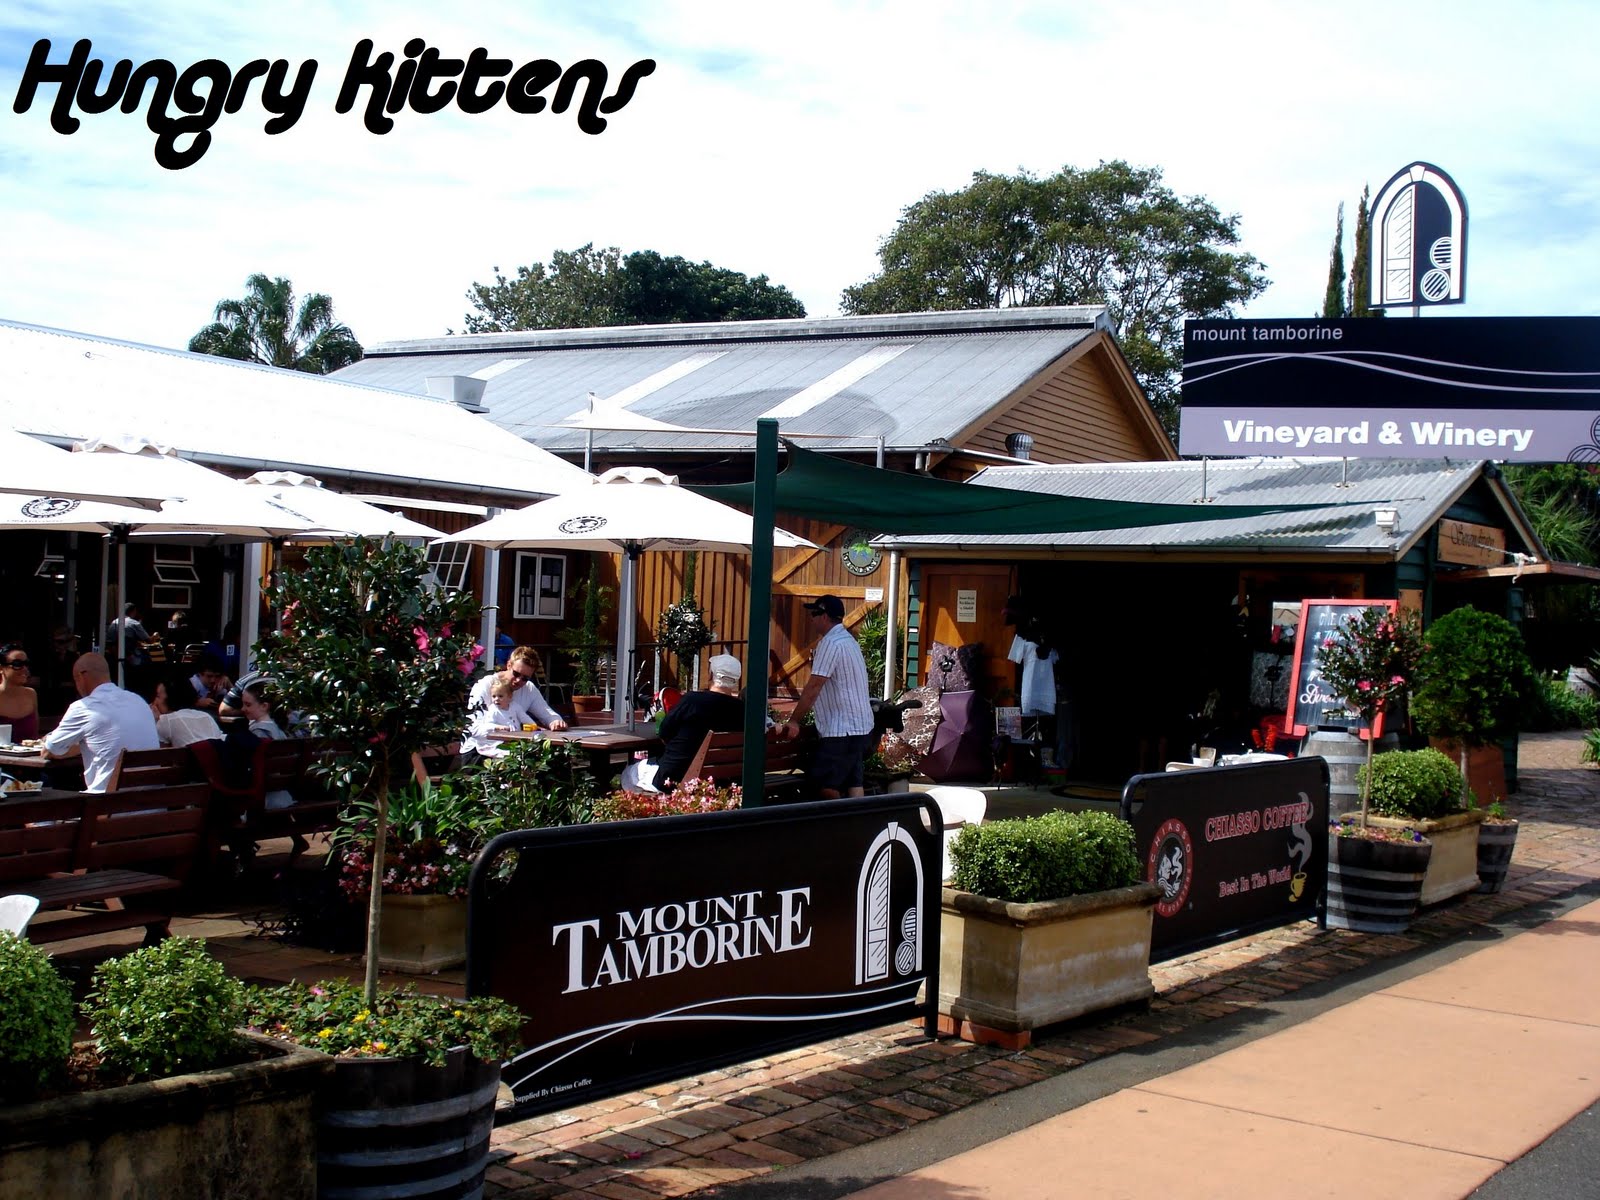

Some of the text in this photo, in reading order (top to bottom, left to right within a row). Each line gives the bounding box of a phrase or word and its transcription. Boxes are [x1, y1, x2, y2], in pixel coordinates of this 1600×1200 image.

[1192, 325, 1343, 341] mount tamborine
[1223, 420, 1534, 451] Vineyard & Winery
[1205, 802, 1309, 842] CHIASSO COFFEE
[1150, 823, 1191, 863] CHIASSO
[1219, 865, 1292, 897] Best In The World
[617, 890, 762, 940] MOUNT
[552, 886, 813, 994] TAMBORINE
[515, 1090, 541, 1103] Supplied
[541, 1088, 550, 1098] By
[573, 1079, 593, 1089] Coffee
